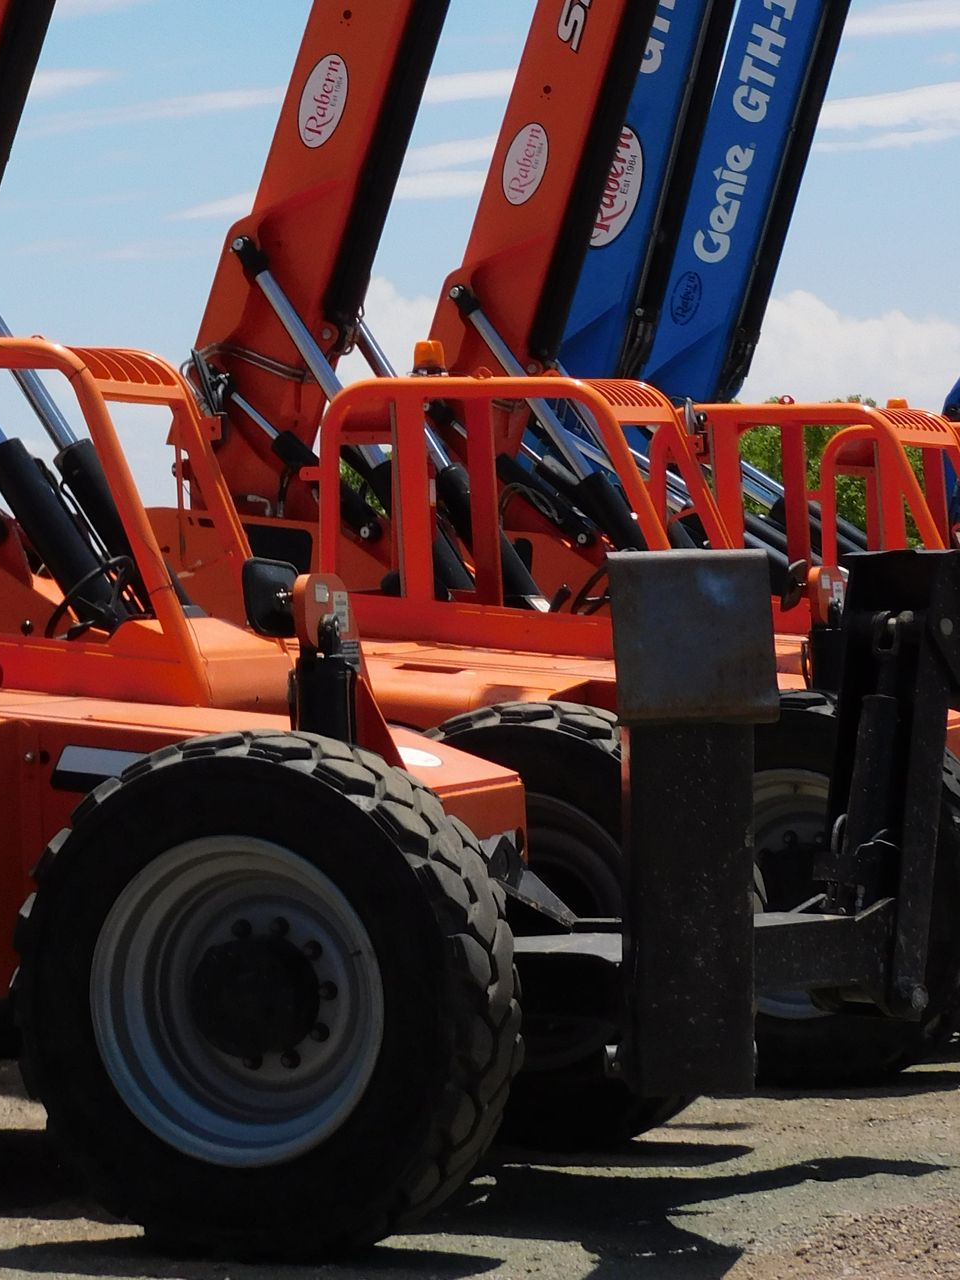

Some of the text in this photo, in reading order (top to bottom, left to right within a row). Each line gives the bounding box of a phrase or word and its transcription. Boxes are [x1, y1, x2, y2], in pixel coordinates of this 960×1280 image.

[304, 60, 341, 142] Rabern
[507, 128, 541, 200] Rabern
[626, 154, 638, 176] 1984
[693, 144, 755, 263] Genie
